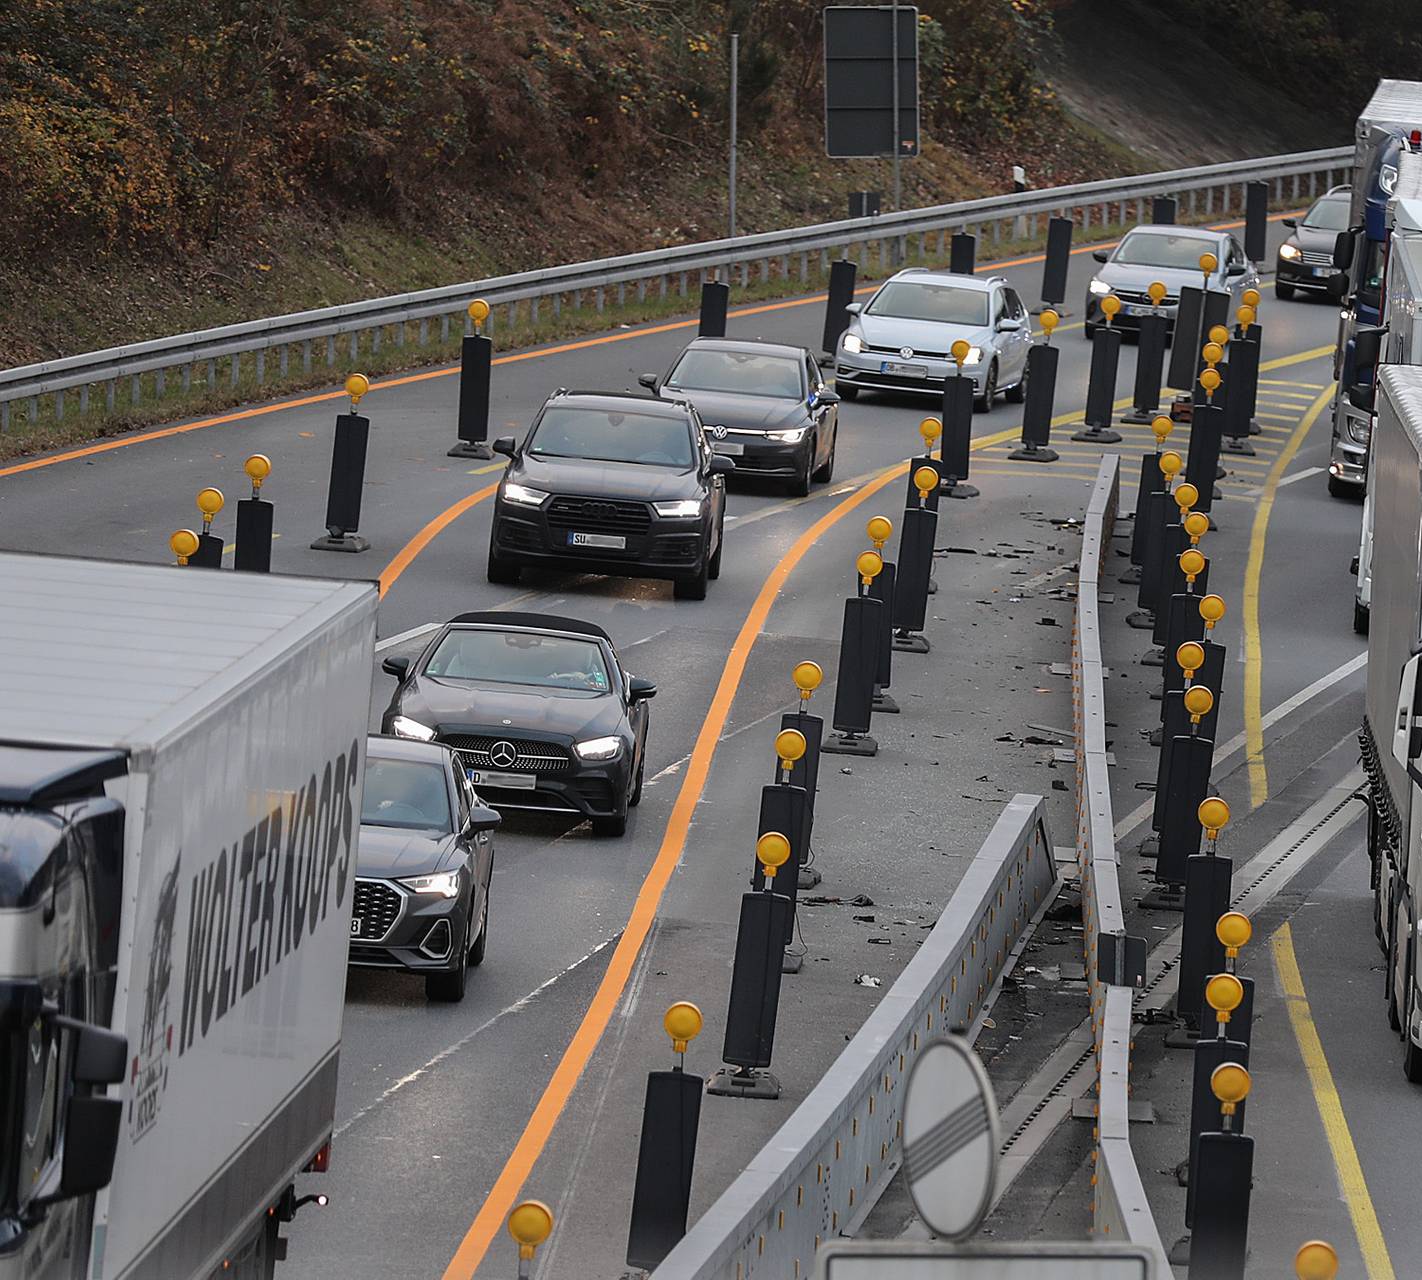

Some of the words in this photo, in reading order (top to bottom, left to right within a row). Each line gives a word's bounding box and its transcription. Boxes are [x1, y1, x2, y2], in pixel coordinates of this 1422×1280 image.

[574, 534, 586, 544] SU
[178, 806, 282, 1057] WOLTER
[275, 738, 358, 965] KOOPS
